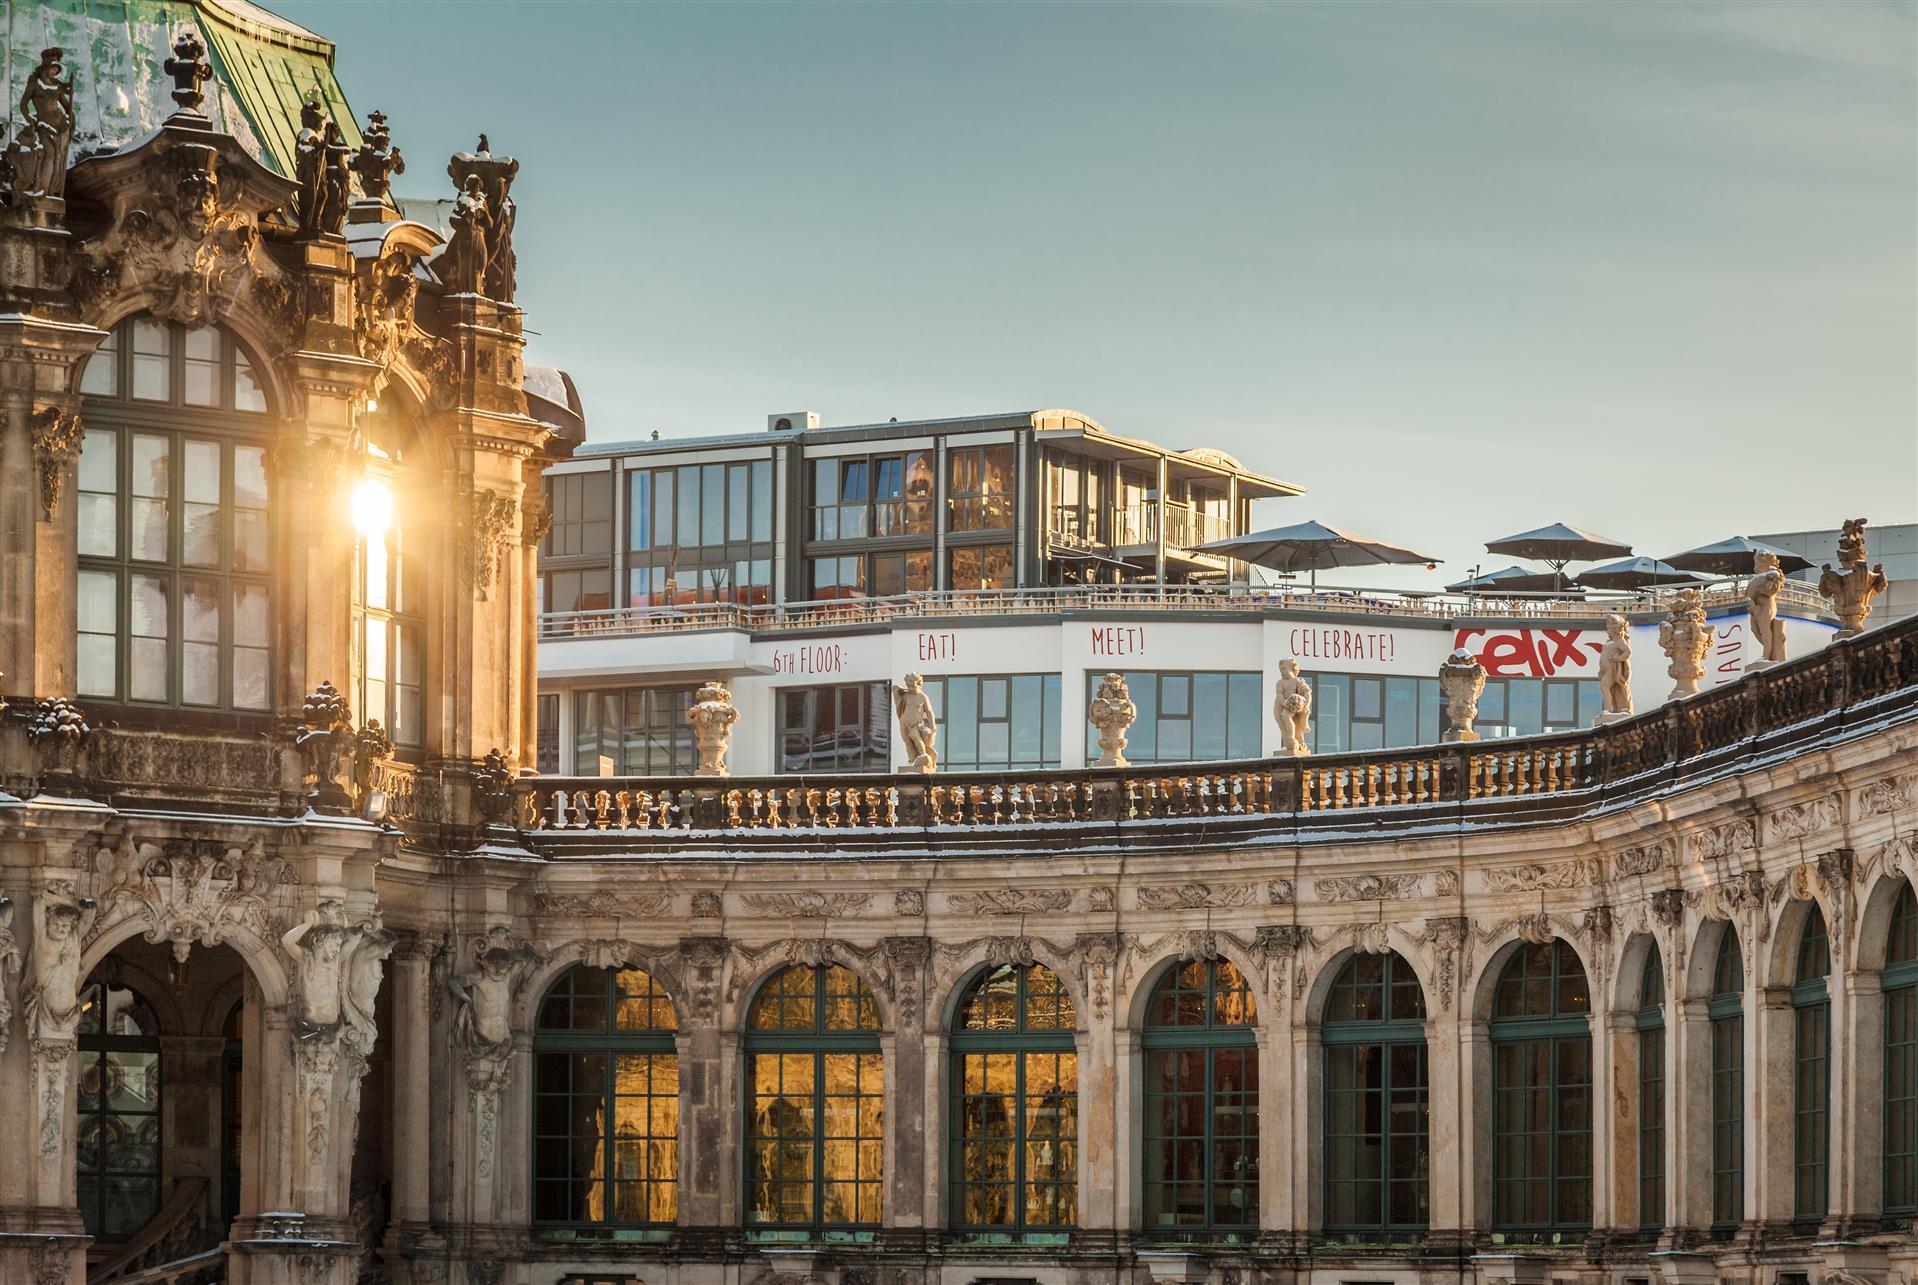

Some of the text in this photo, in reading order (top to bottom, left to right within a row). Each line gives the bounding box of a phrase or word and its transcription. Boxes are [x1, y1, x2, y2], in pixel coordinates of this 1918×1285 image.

[919, 633, 955, 661] EAT!
[1092, 627, 1145, 656] MEET!
[1290, 629, 1395, 662] CELEBRATE!
[1715, 624, 1742, 684] AUS
[801, 645, 848, 674] FLOOR:
